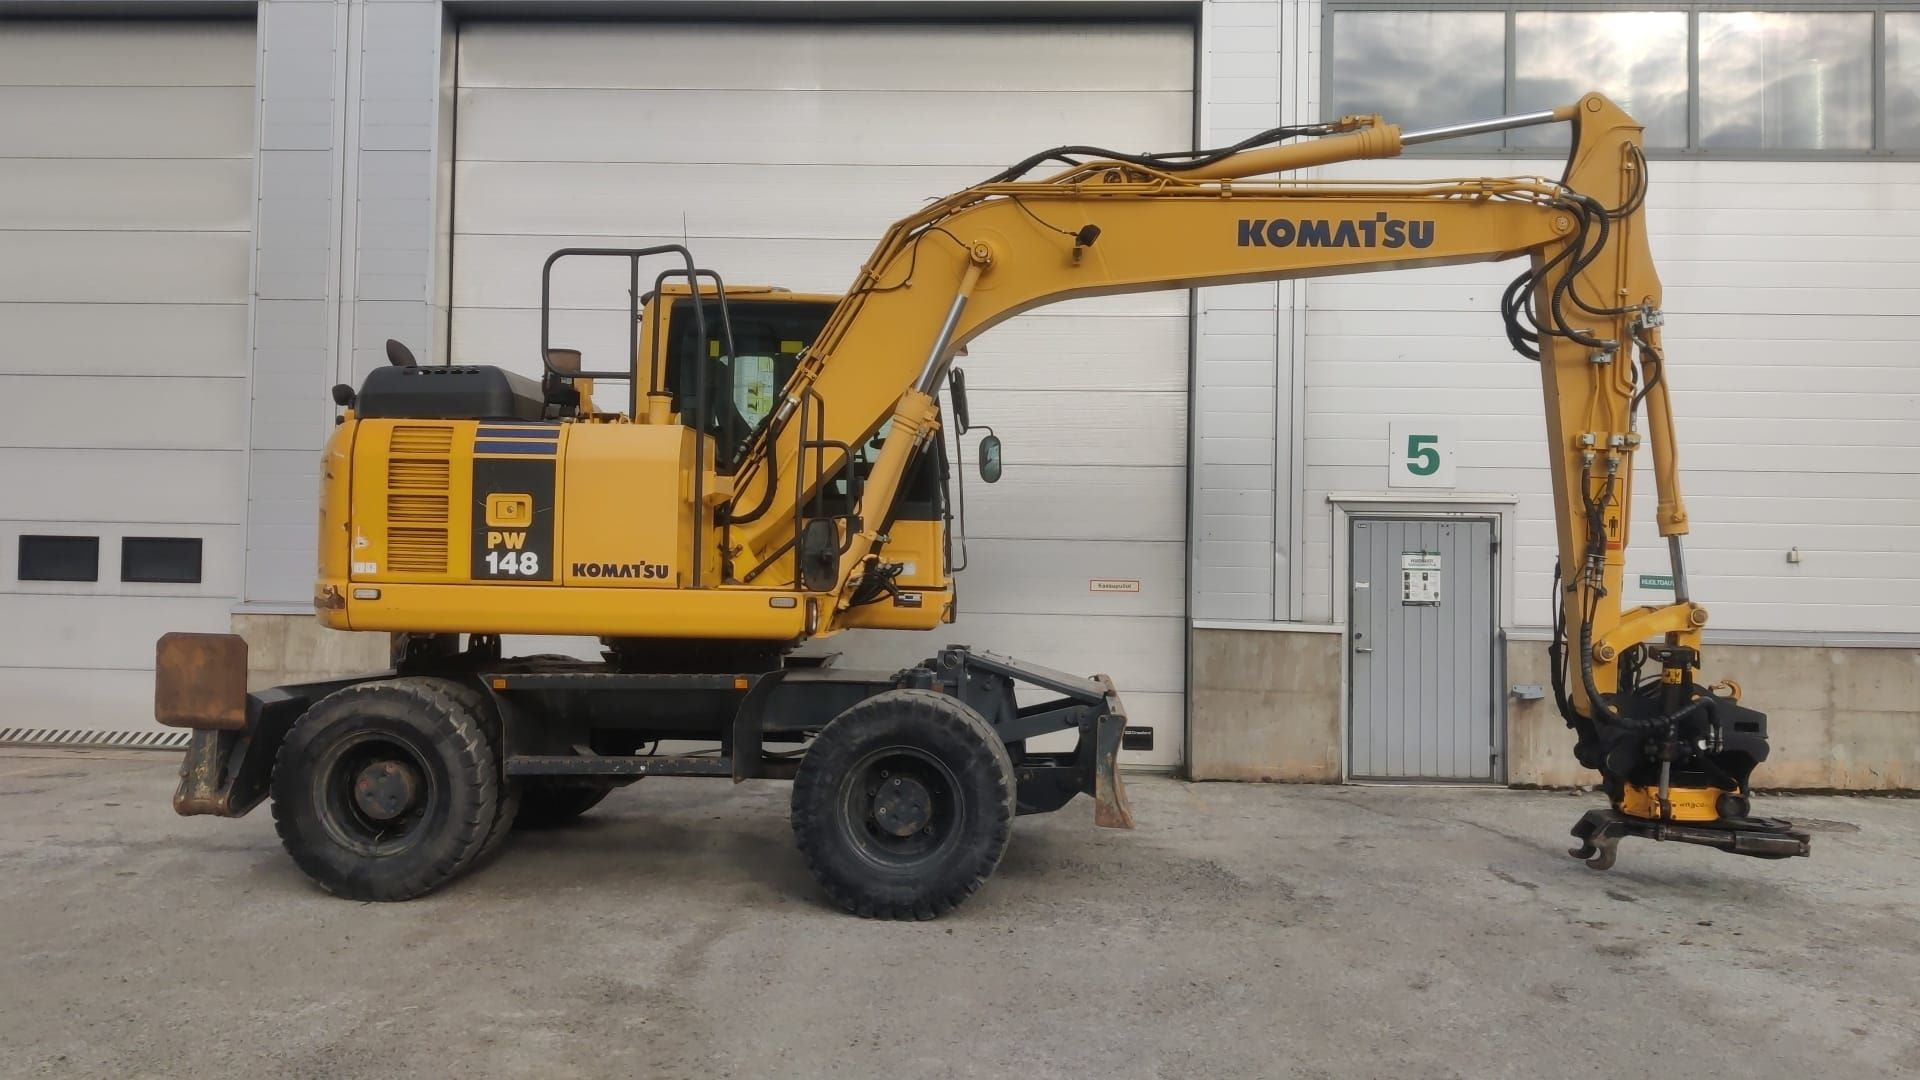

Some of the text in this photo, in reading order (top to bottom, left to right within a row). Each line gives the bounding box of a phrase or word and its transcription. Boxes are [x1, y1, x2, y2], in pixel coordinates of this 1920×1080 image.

[1238, 212, 1434, 248] KOMATSU
[1406, 434, 1440, 476] 5
[487, 532, 526, 549] PW
[485, 551, 538, 575] 148
[572, 561, 669, 579] KOMATSU
